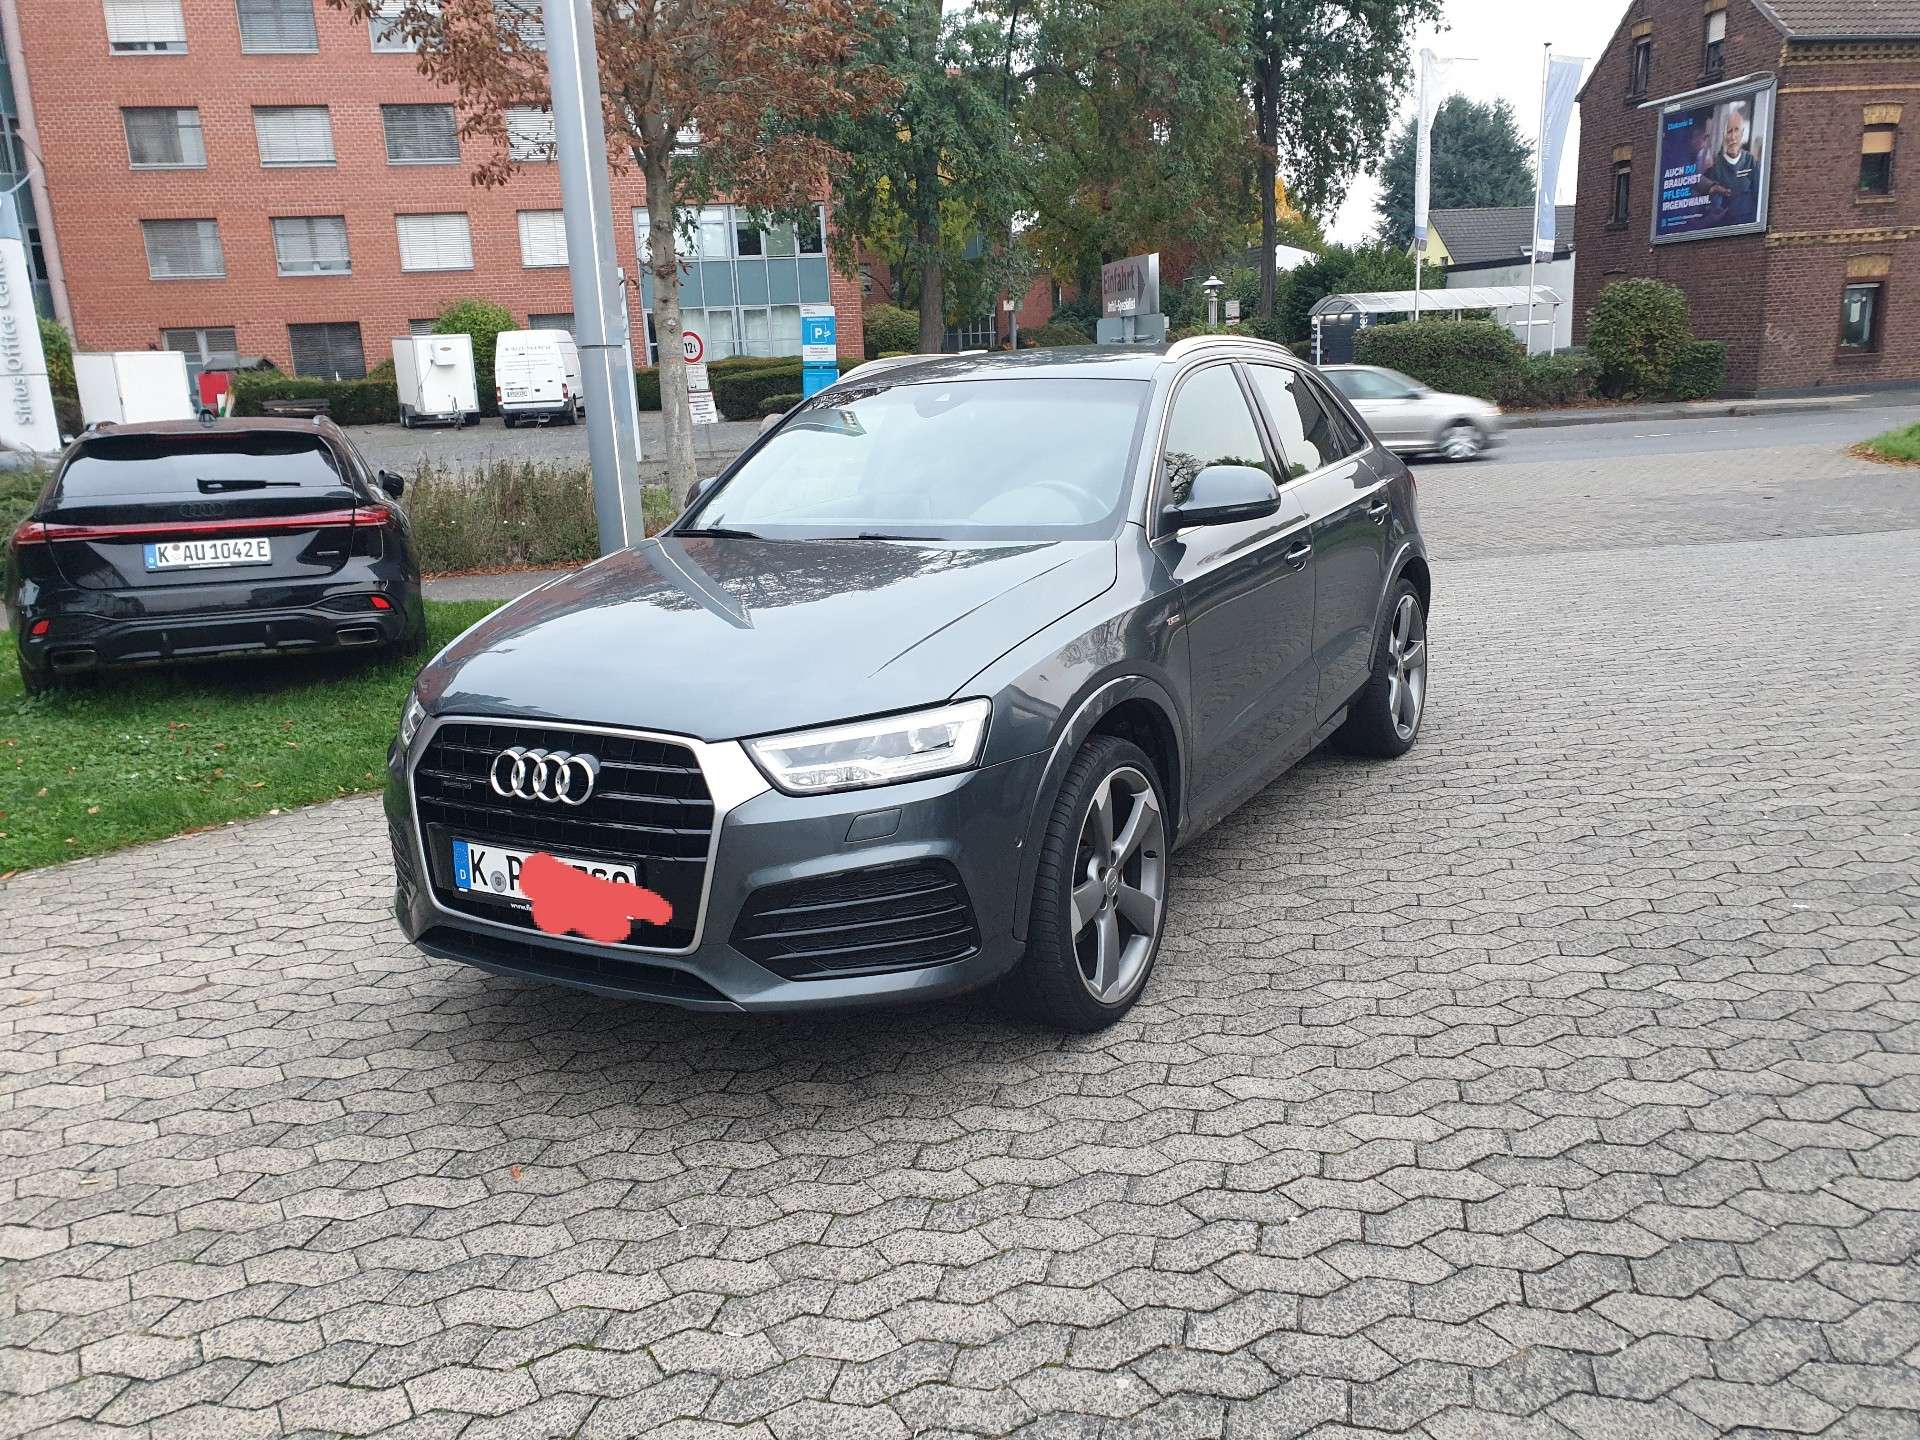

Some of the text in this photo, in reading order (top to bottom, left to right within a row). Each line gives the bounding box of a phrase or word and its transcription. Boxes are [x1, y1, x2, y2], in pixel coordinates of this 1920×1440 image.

[1664, 164, 1696, 178] AUCH DU
[1663, 174, 1702, 189] BRAUCHST
[1663, 187, 1692, 200] PFLEGE.
[1662, 195, 1711, 211] IRGENDWANN.
[1104, 265, 1135, 295] Einfahrt
[815, 328, 822, 339] P
[1, 315, 23, 373] Office
[158, 546, 169, 562] K
[184, 544, 206, 561] AU
[460, 869, 467, 880] D
[471, 848, 488, 886] K
